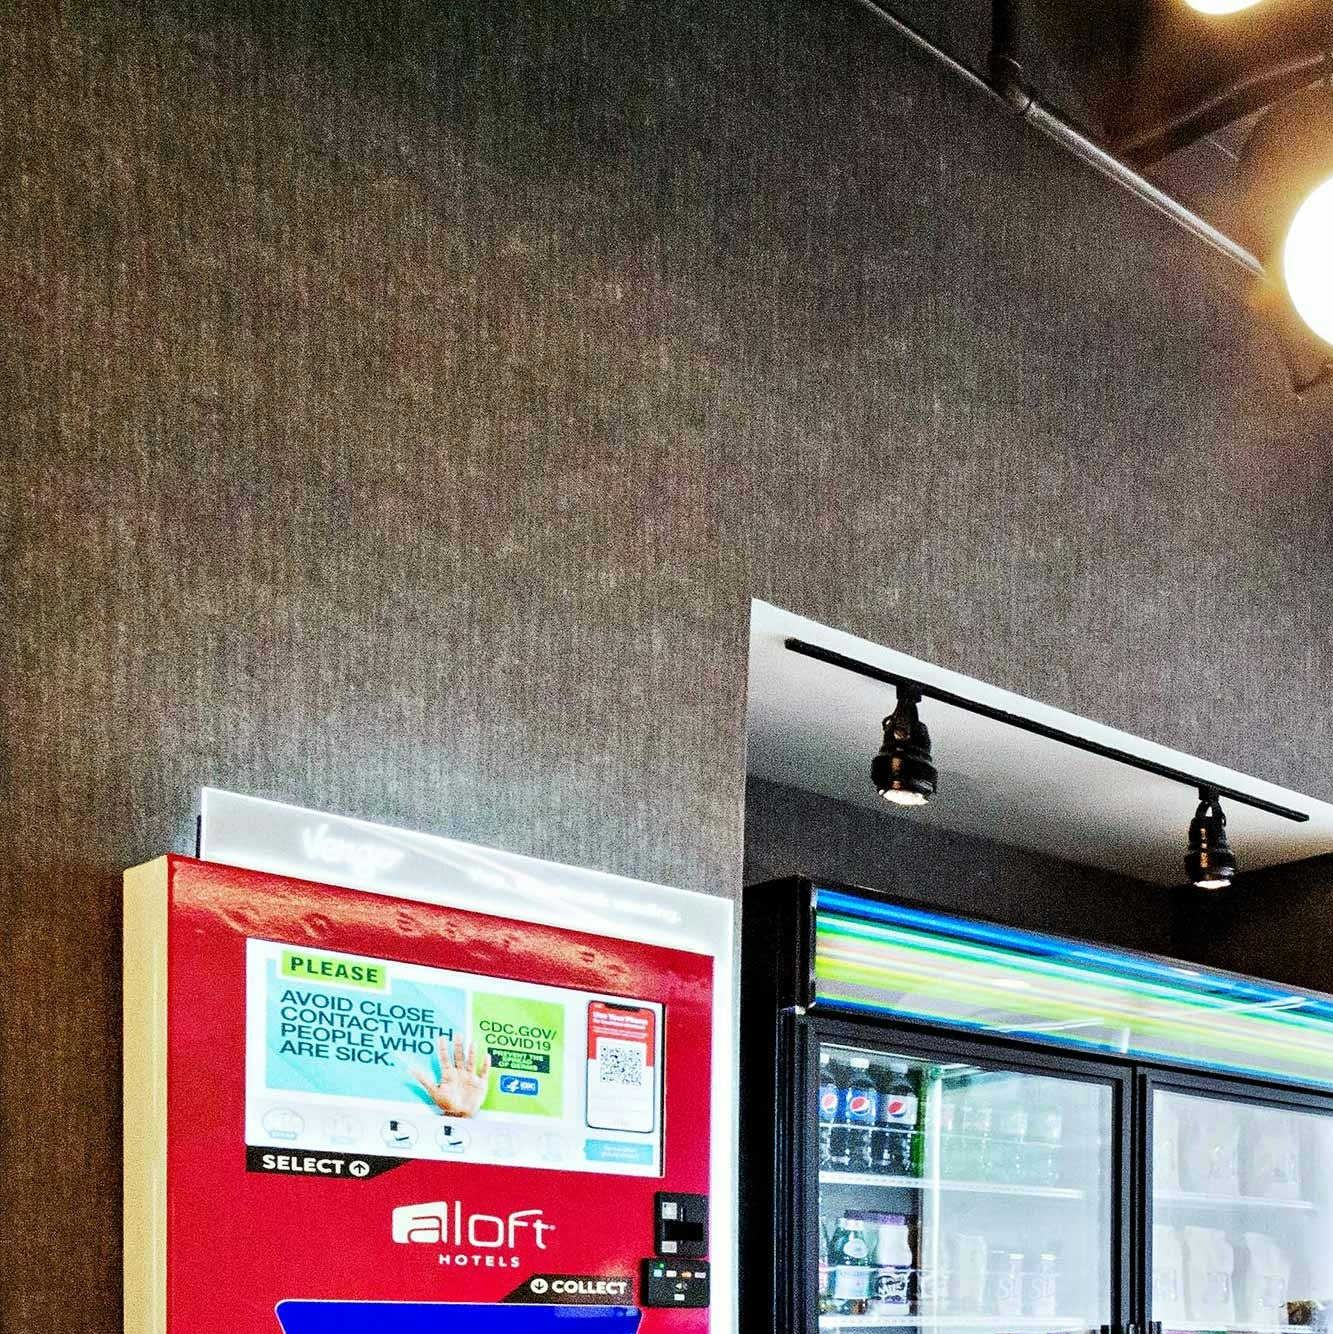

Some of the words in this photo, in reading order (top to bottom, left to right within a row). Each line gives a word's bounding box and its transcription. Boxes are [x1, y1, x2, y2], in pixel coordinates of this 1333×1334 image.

[290, 956, 378, 983] PLEASE
[280, 989, 353, 1011] AVOID
[360, 1000, 435, 1023] CLOSE
[281, 1006, 393, 1033] CONTACT
[399, 1022, 453, 1041] WITH
[479, 1020, 557, 1040] CDC.GOV/
[281, 1023, 375, 1048] PEOPLE
[380, 1035, 434, 1054] WHO
[485, 1033, 551, 1051] COVID19
[279, 1040, 329, 1058] ARE
[335, 1046, 394, 1066] SICK.
[262, 1154, 345, 1175] SELECT
[392, 1200, 547, 1250] aloft
[439, 1254, 520, 1268] HOTELS
[551, 1280, 627, 1295] COLLECT
